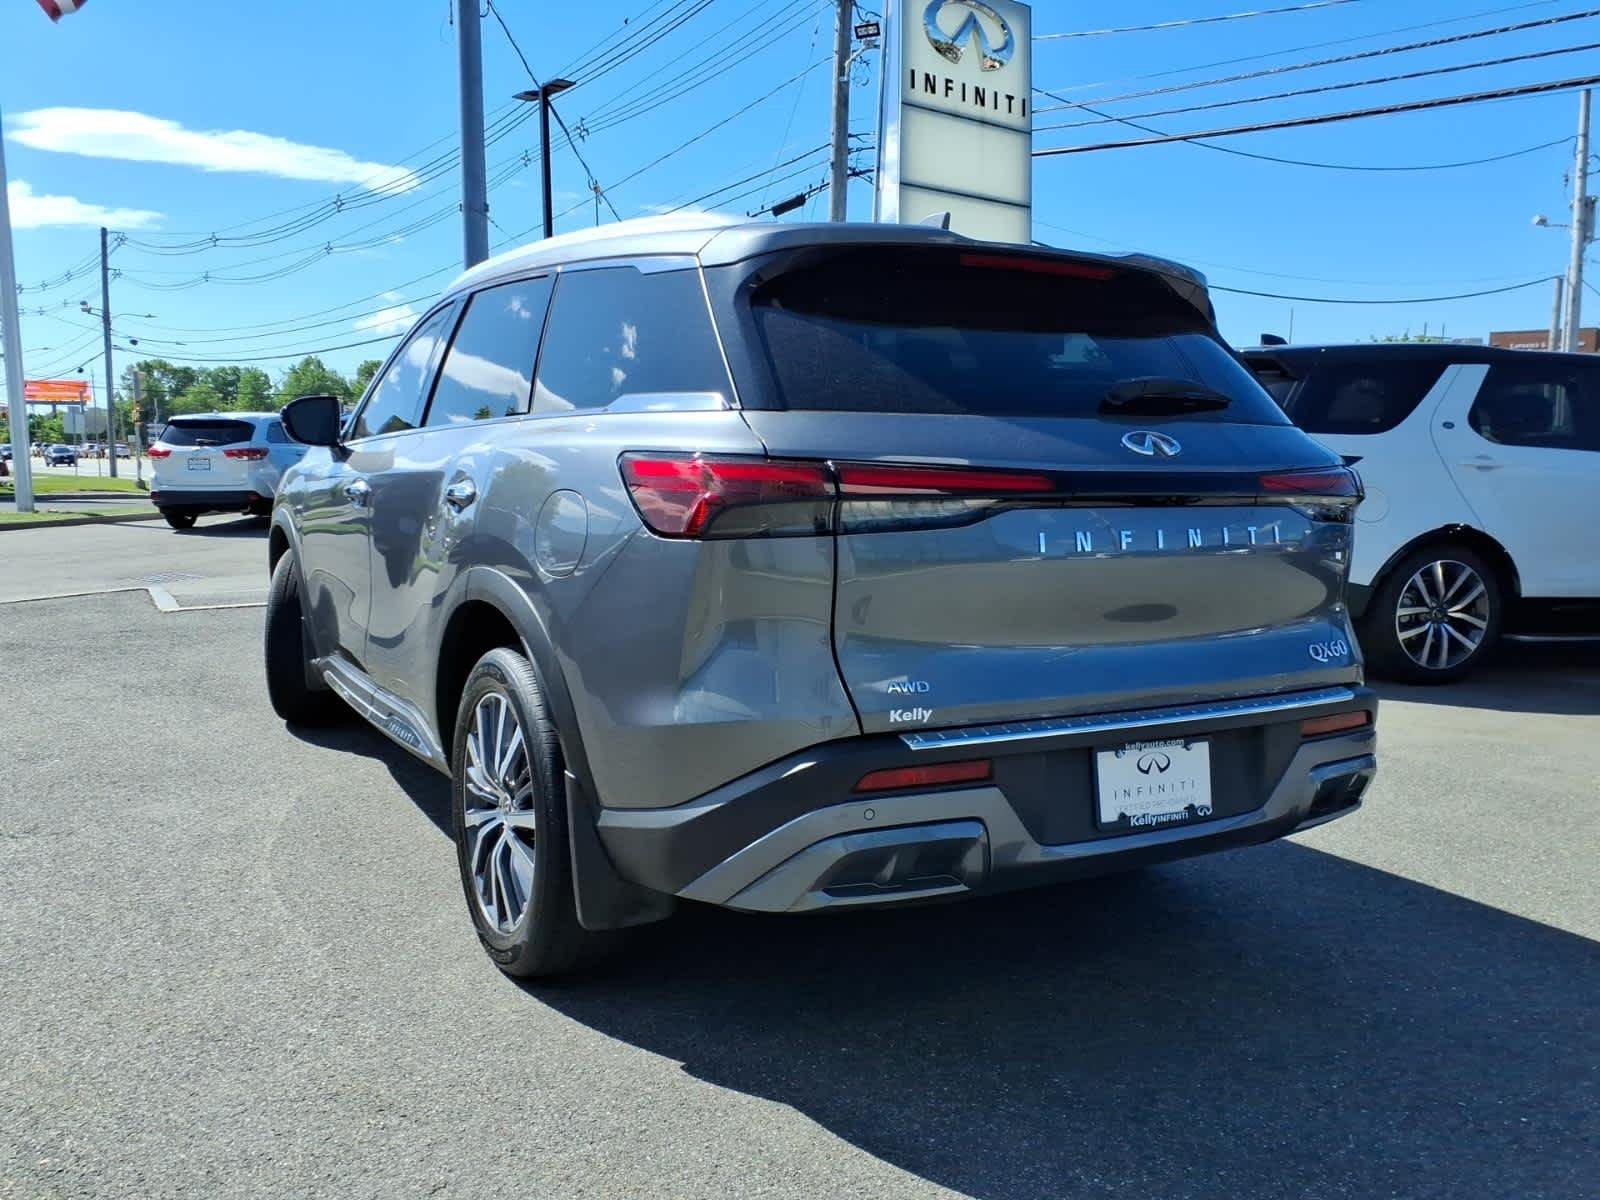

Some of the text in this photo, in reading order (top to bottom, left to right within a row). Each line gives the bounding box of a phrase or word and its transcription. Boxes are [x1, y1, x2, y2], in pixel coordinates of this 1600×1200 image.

[910, 69, 1026, 117] INFINITI
[1039, 525, 1280, 553] INFINITI
[1309, 640, 1347, 662] QX60
[888, 680, 929, 693] AWD
[889, 707, 933, 723] Kelly
[1113, 780, 1195, 801] INFINITI
